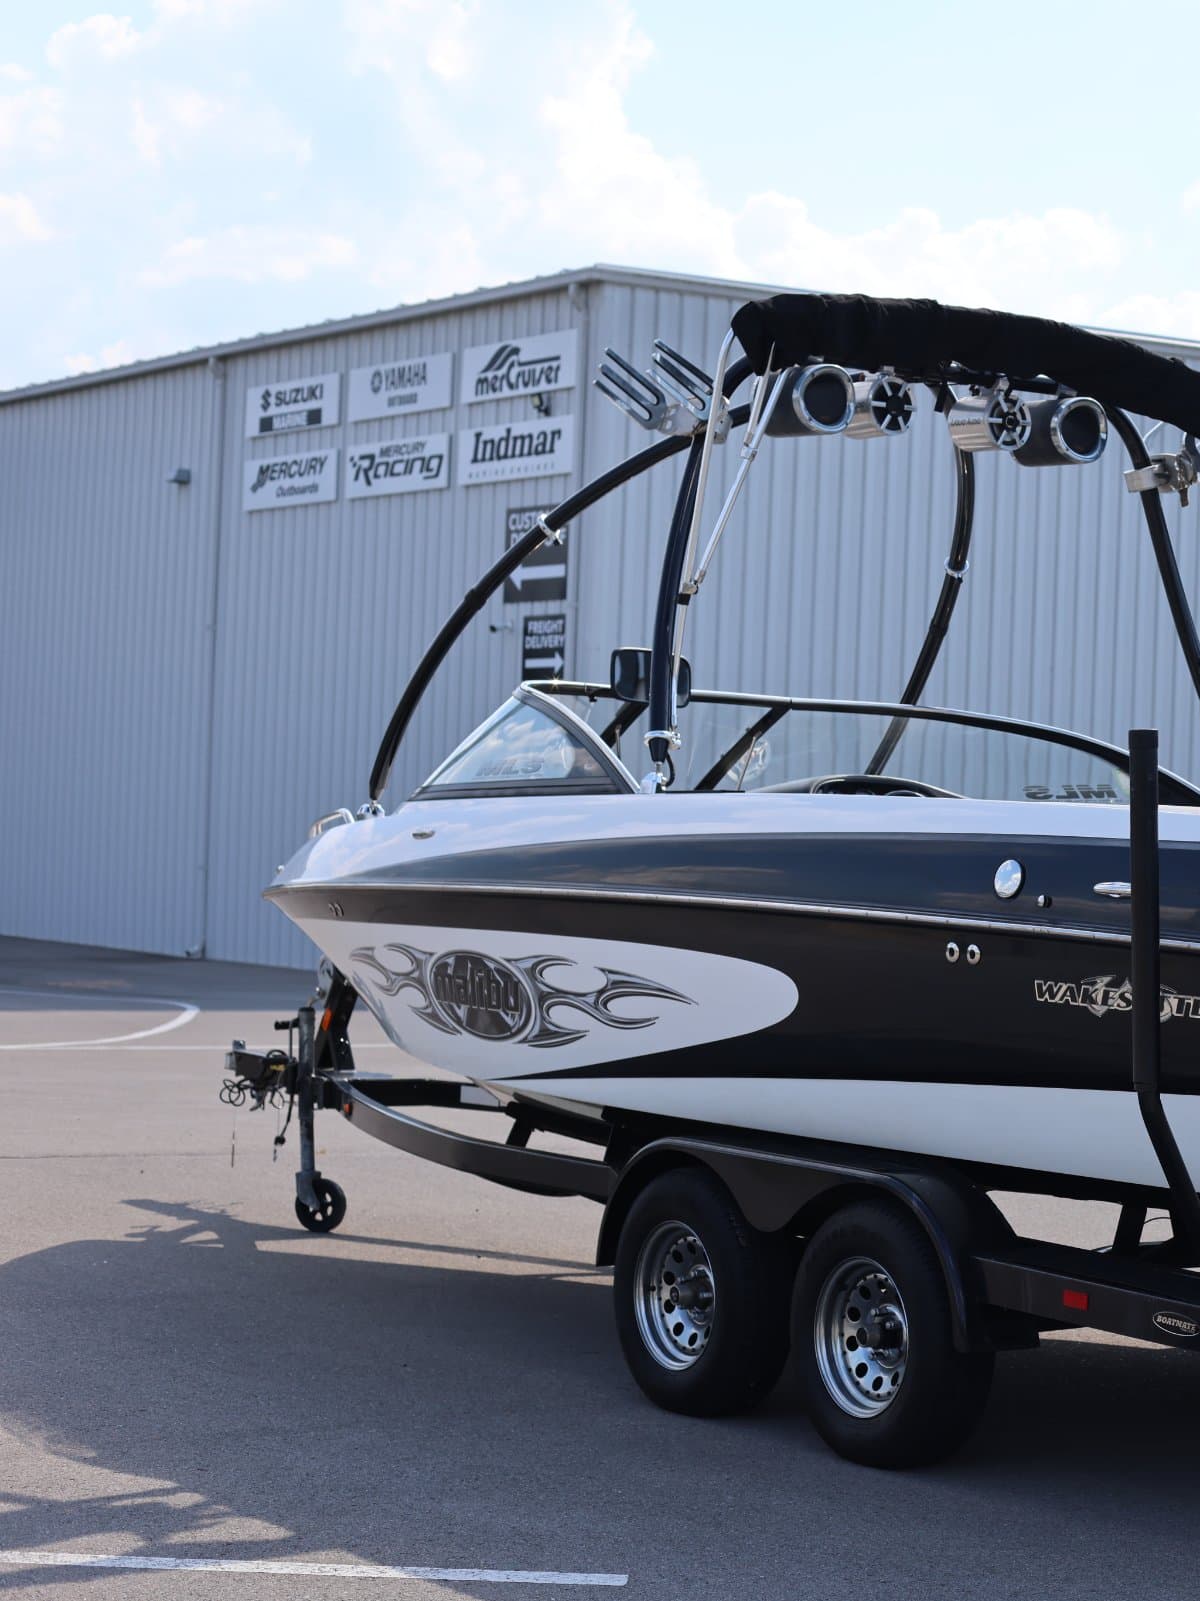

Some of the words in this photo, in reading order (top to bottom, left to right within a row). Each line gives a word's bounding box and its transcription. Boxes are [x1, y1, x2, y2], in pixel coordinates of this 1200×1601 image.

[384, 362, 428, 391] YAMAHA
[275, 383, 324, 407] SUZUKI
[379, 441, 427, 458] MERCURY
[470, 427, 562, 464] Indmar
[252, 455, 329, 493] MERCURY
[352, 453, 444, 487] Racing
[527, 619, 563, 634] FREIGHT
[525, 634, 564, 649] DELIVERY
[433, 958, 521, 1014] malibu
[1156, 1315, 1196, 1333] BOATMATE
